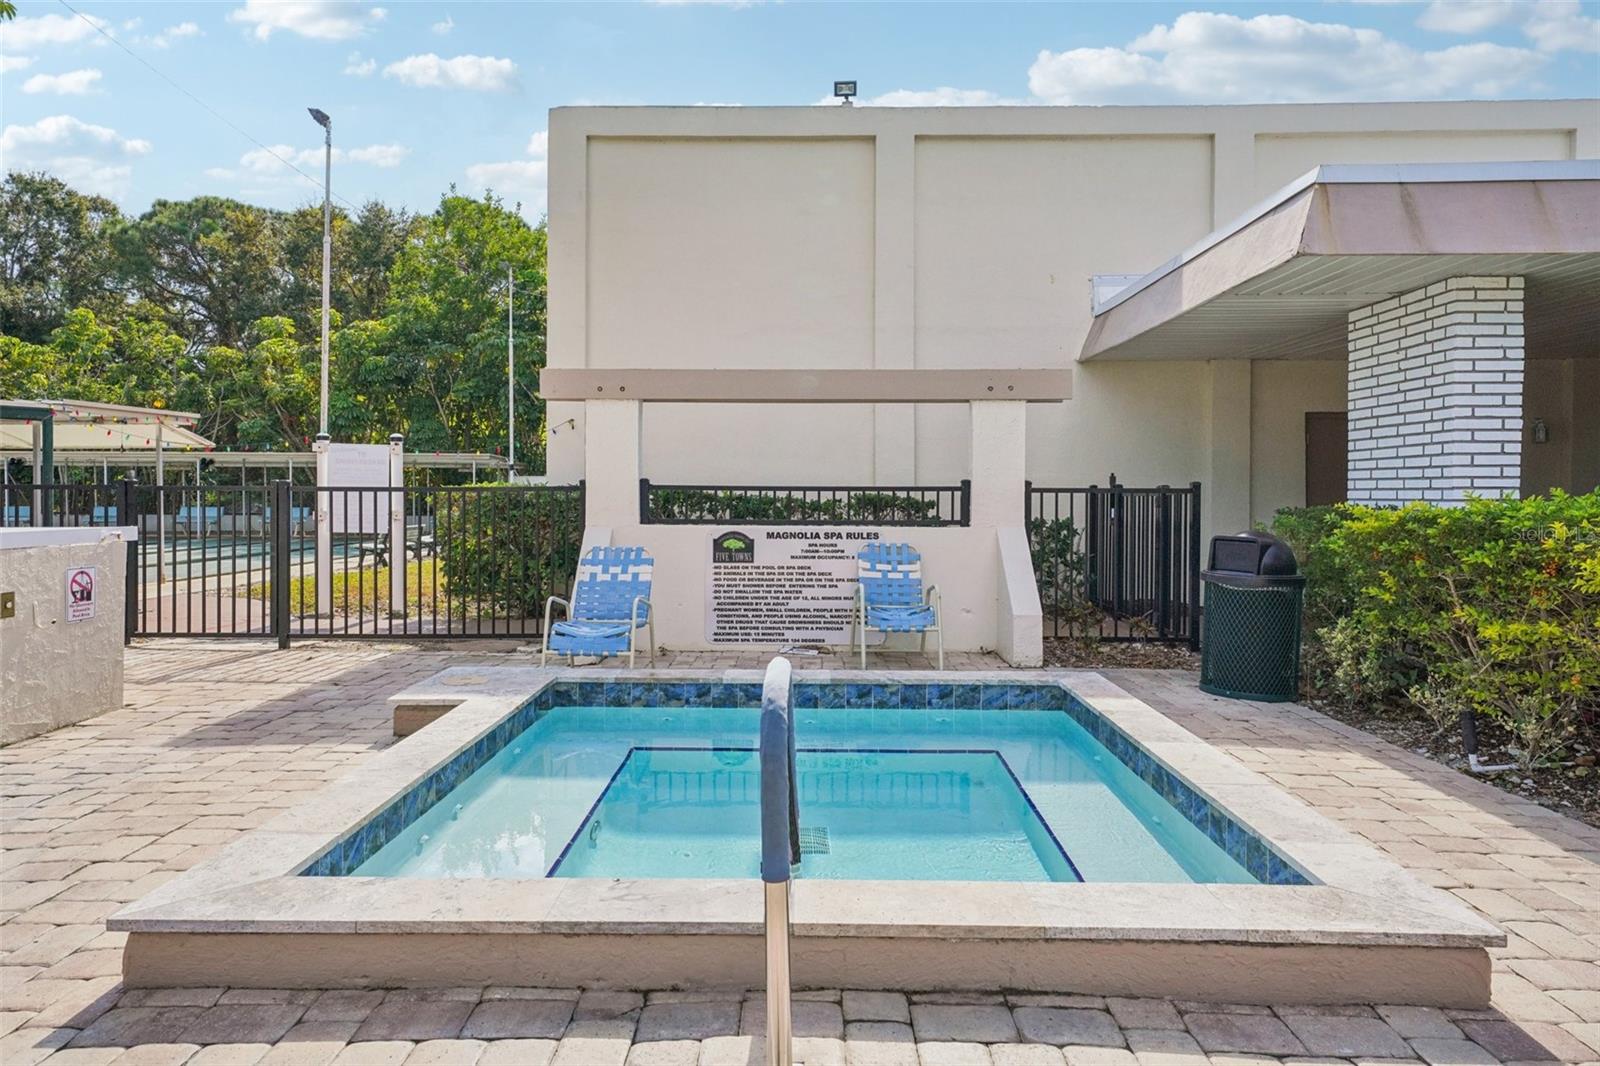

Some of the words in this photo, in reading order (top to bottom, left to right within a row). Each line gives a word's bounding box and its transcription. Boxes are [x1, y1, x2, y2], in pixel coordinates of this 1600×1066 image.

[766, 532, 821, 540] MAGNOLIA
[823, 532, 843, 540] SPA
[846, 532, 880, 540] RULES
[716, 552, 730, 561] FIVE
[731, 552, 752, 561] TOWNS
